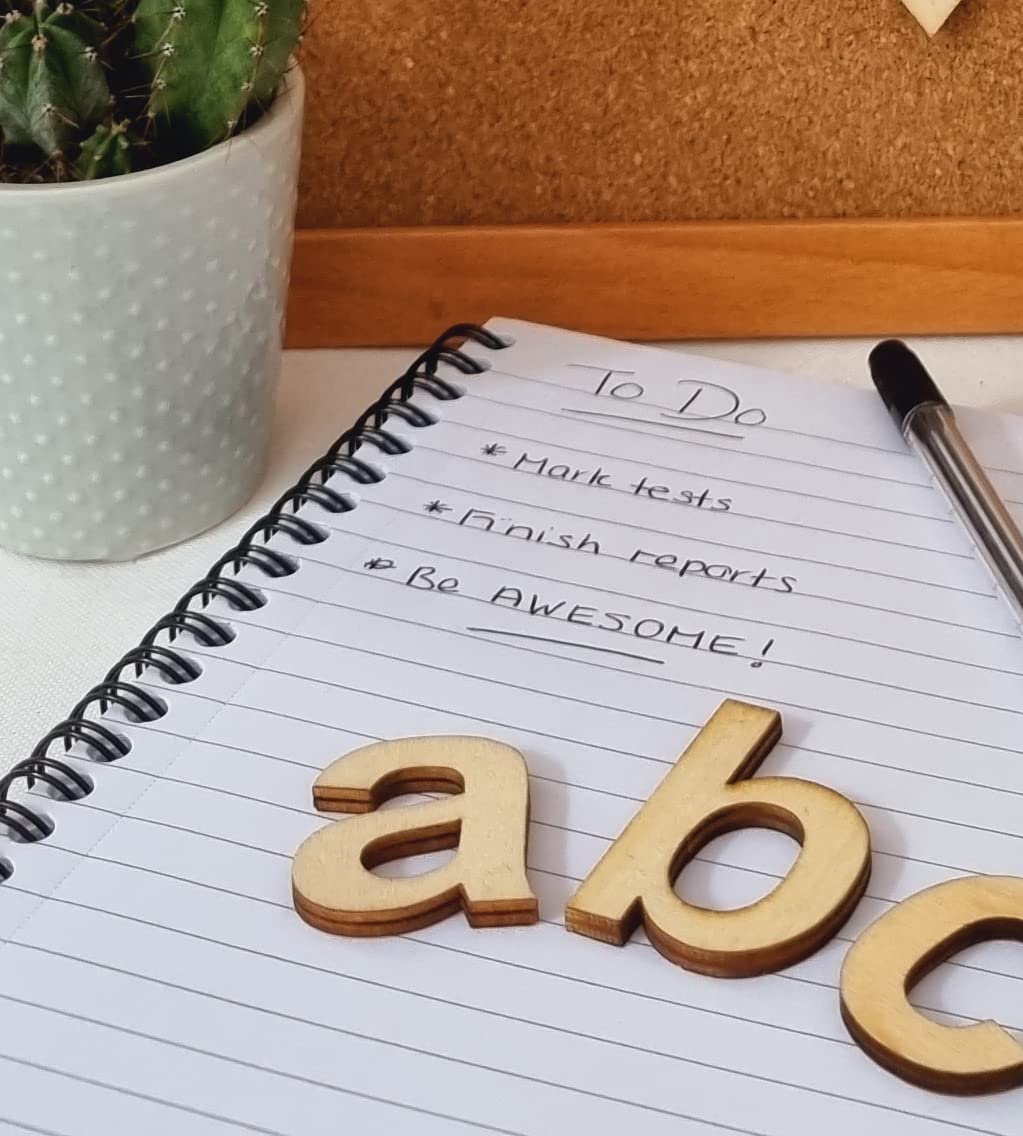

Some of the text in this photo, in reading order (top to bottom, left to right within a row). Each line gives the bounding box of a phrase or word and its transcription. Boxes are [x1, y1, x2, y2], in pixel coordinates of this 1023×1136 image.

[567, 364, 767, 426] To Do
[512, 452, 733, 512] Mark tests
[405, 566, 460, 594] Be
[457, 507, 799, 594] Finish reports
